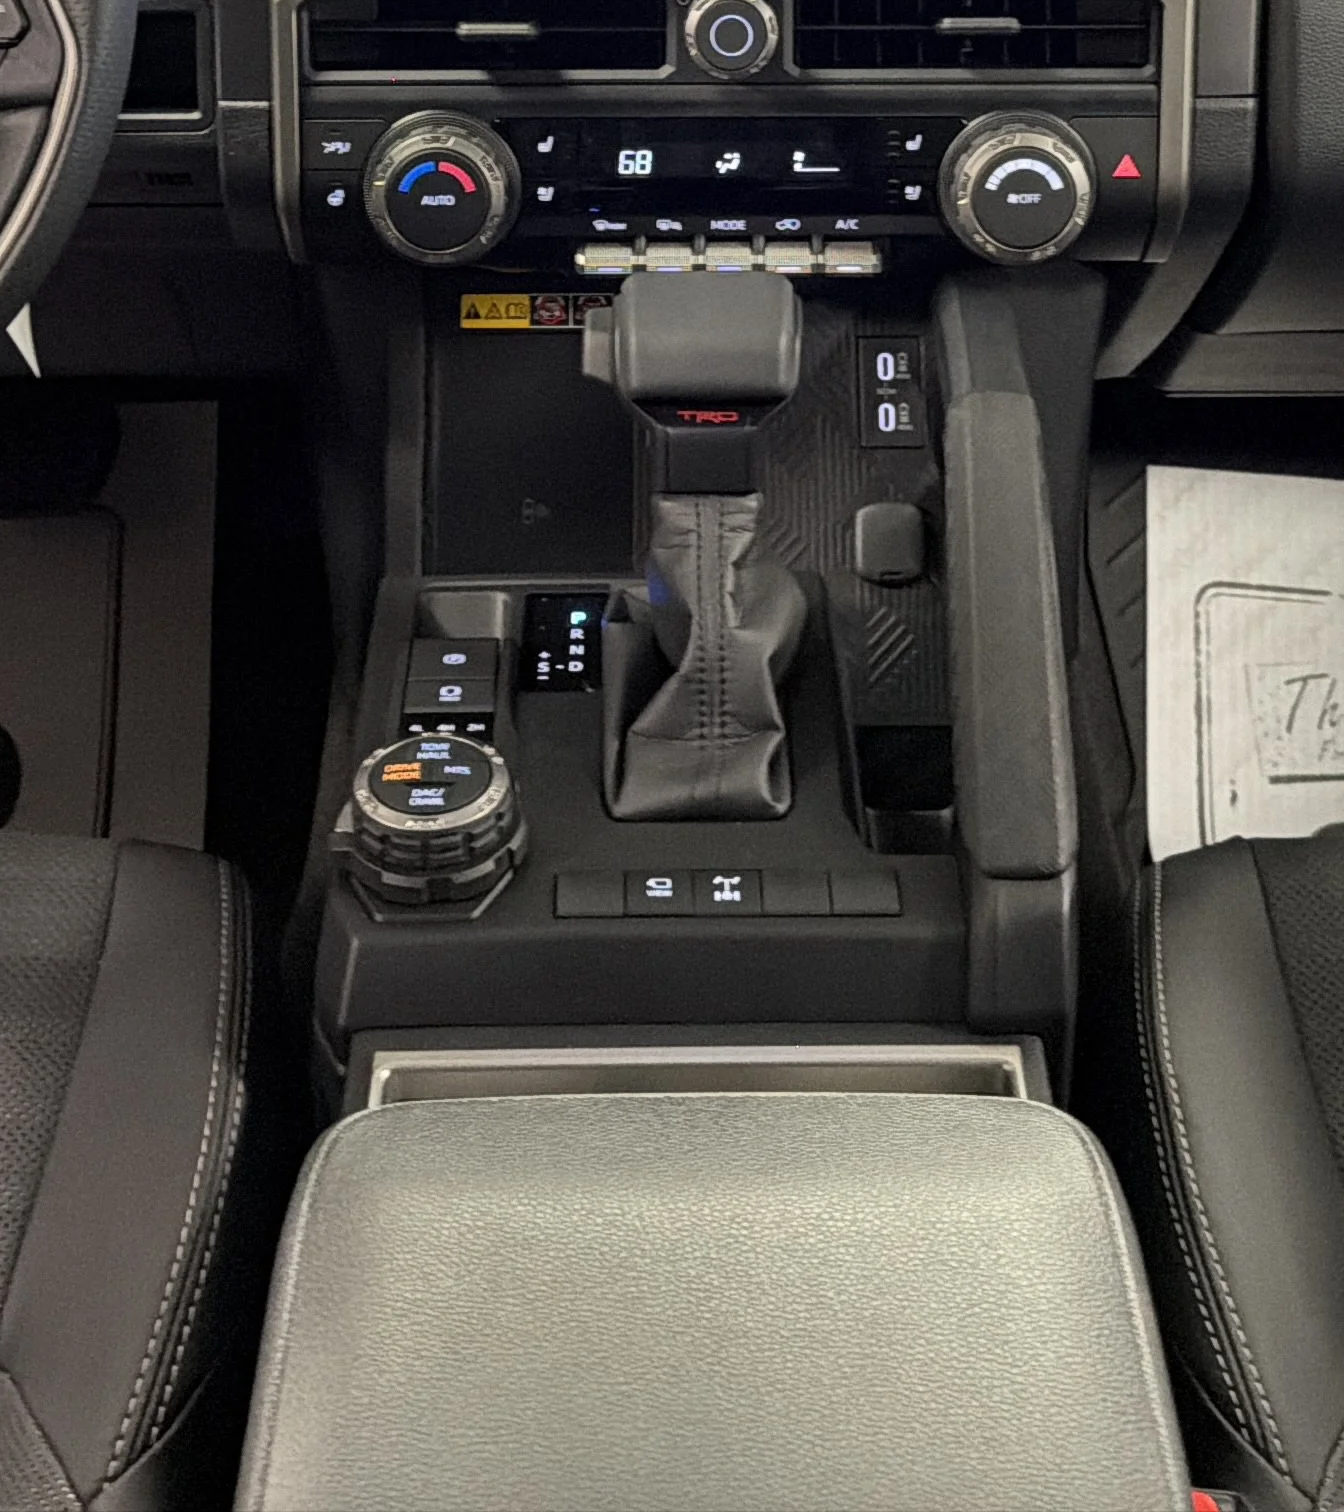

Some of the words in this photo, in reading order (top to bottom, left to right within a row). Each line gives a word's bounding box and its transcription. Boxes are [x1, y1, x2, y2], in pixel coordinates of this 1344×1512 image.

[618, 150, 653, 175] 68
[421, 195, 456, 206] AUTO
[710, 220, 746, 230] MODE
[835, 219, 859, 230] A/C
[677, 410, 740, 424] TRD
[570, 611, 587, 625] P
[570, 628, 585, 639] R
[569, 644, 585, 655] N
[568, 661, 584, 672] D
[383, 763, 422, 773] DRIVE
[382, 771, 422, 781] MODE
